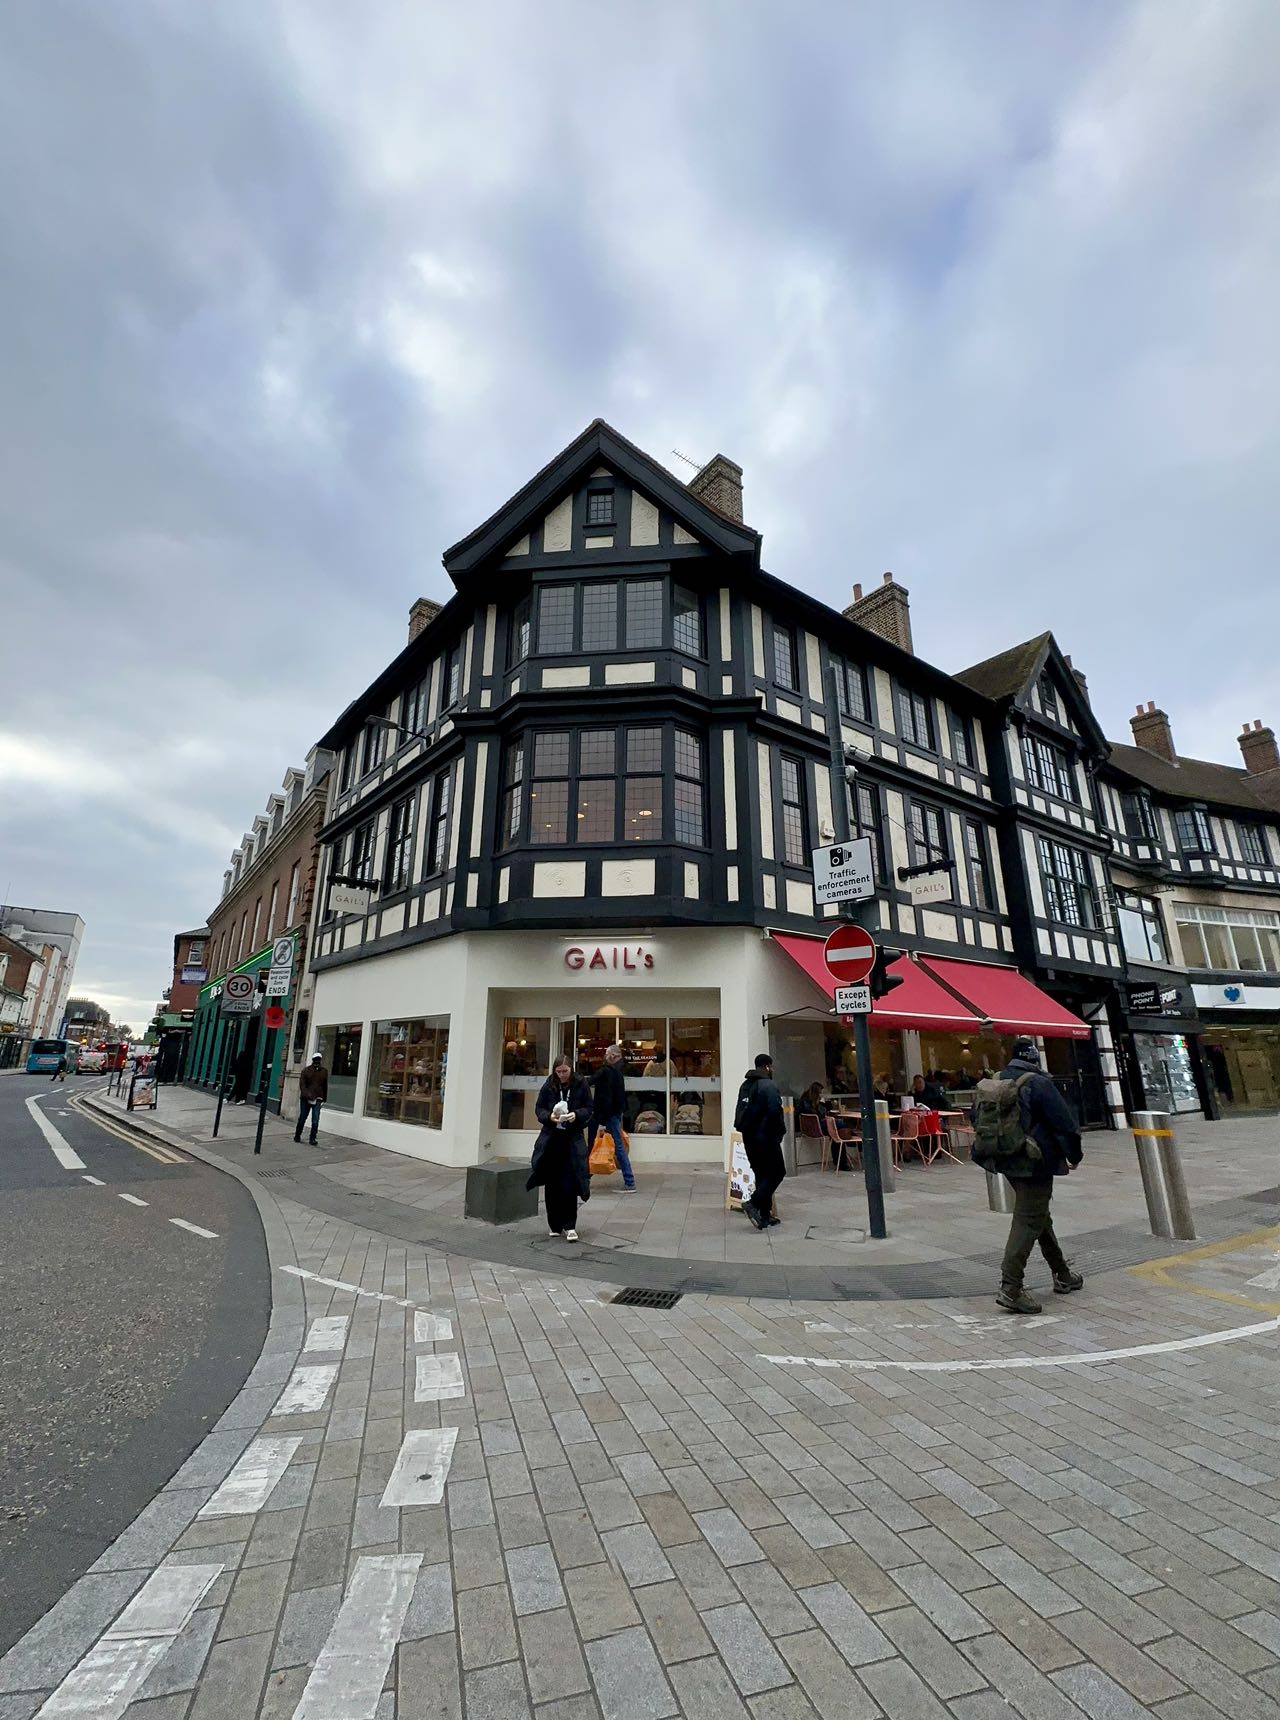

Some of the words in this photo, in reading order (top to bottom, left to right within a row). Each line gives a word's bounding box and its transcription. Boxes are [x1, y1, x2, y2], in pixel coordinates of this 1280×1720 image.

[829, 868, 856, 880] Traffic
[817, 874, 870, 891] enforcement
[826, 886, 862, 899] cameras
[915, 883, 945, 895] GAIL's
[564, 946, 654, 970] GAIL's
[230, 981, 250, 992] 30
[268, 986, 287, 994] ENDS
[838, 990, 867, 999] Except
[1130, 990, 1155, 999] PHONE
[840, 1001, 867, 1010] cycles
[1133, 996, 1154, 1005] POINT
